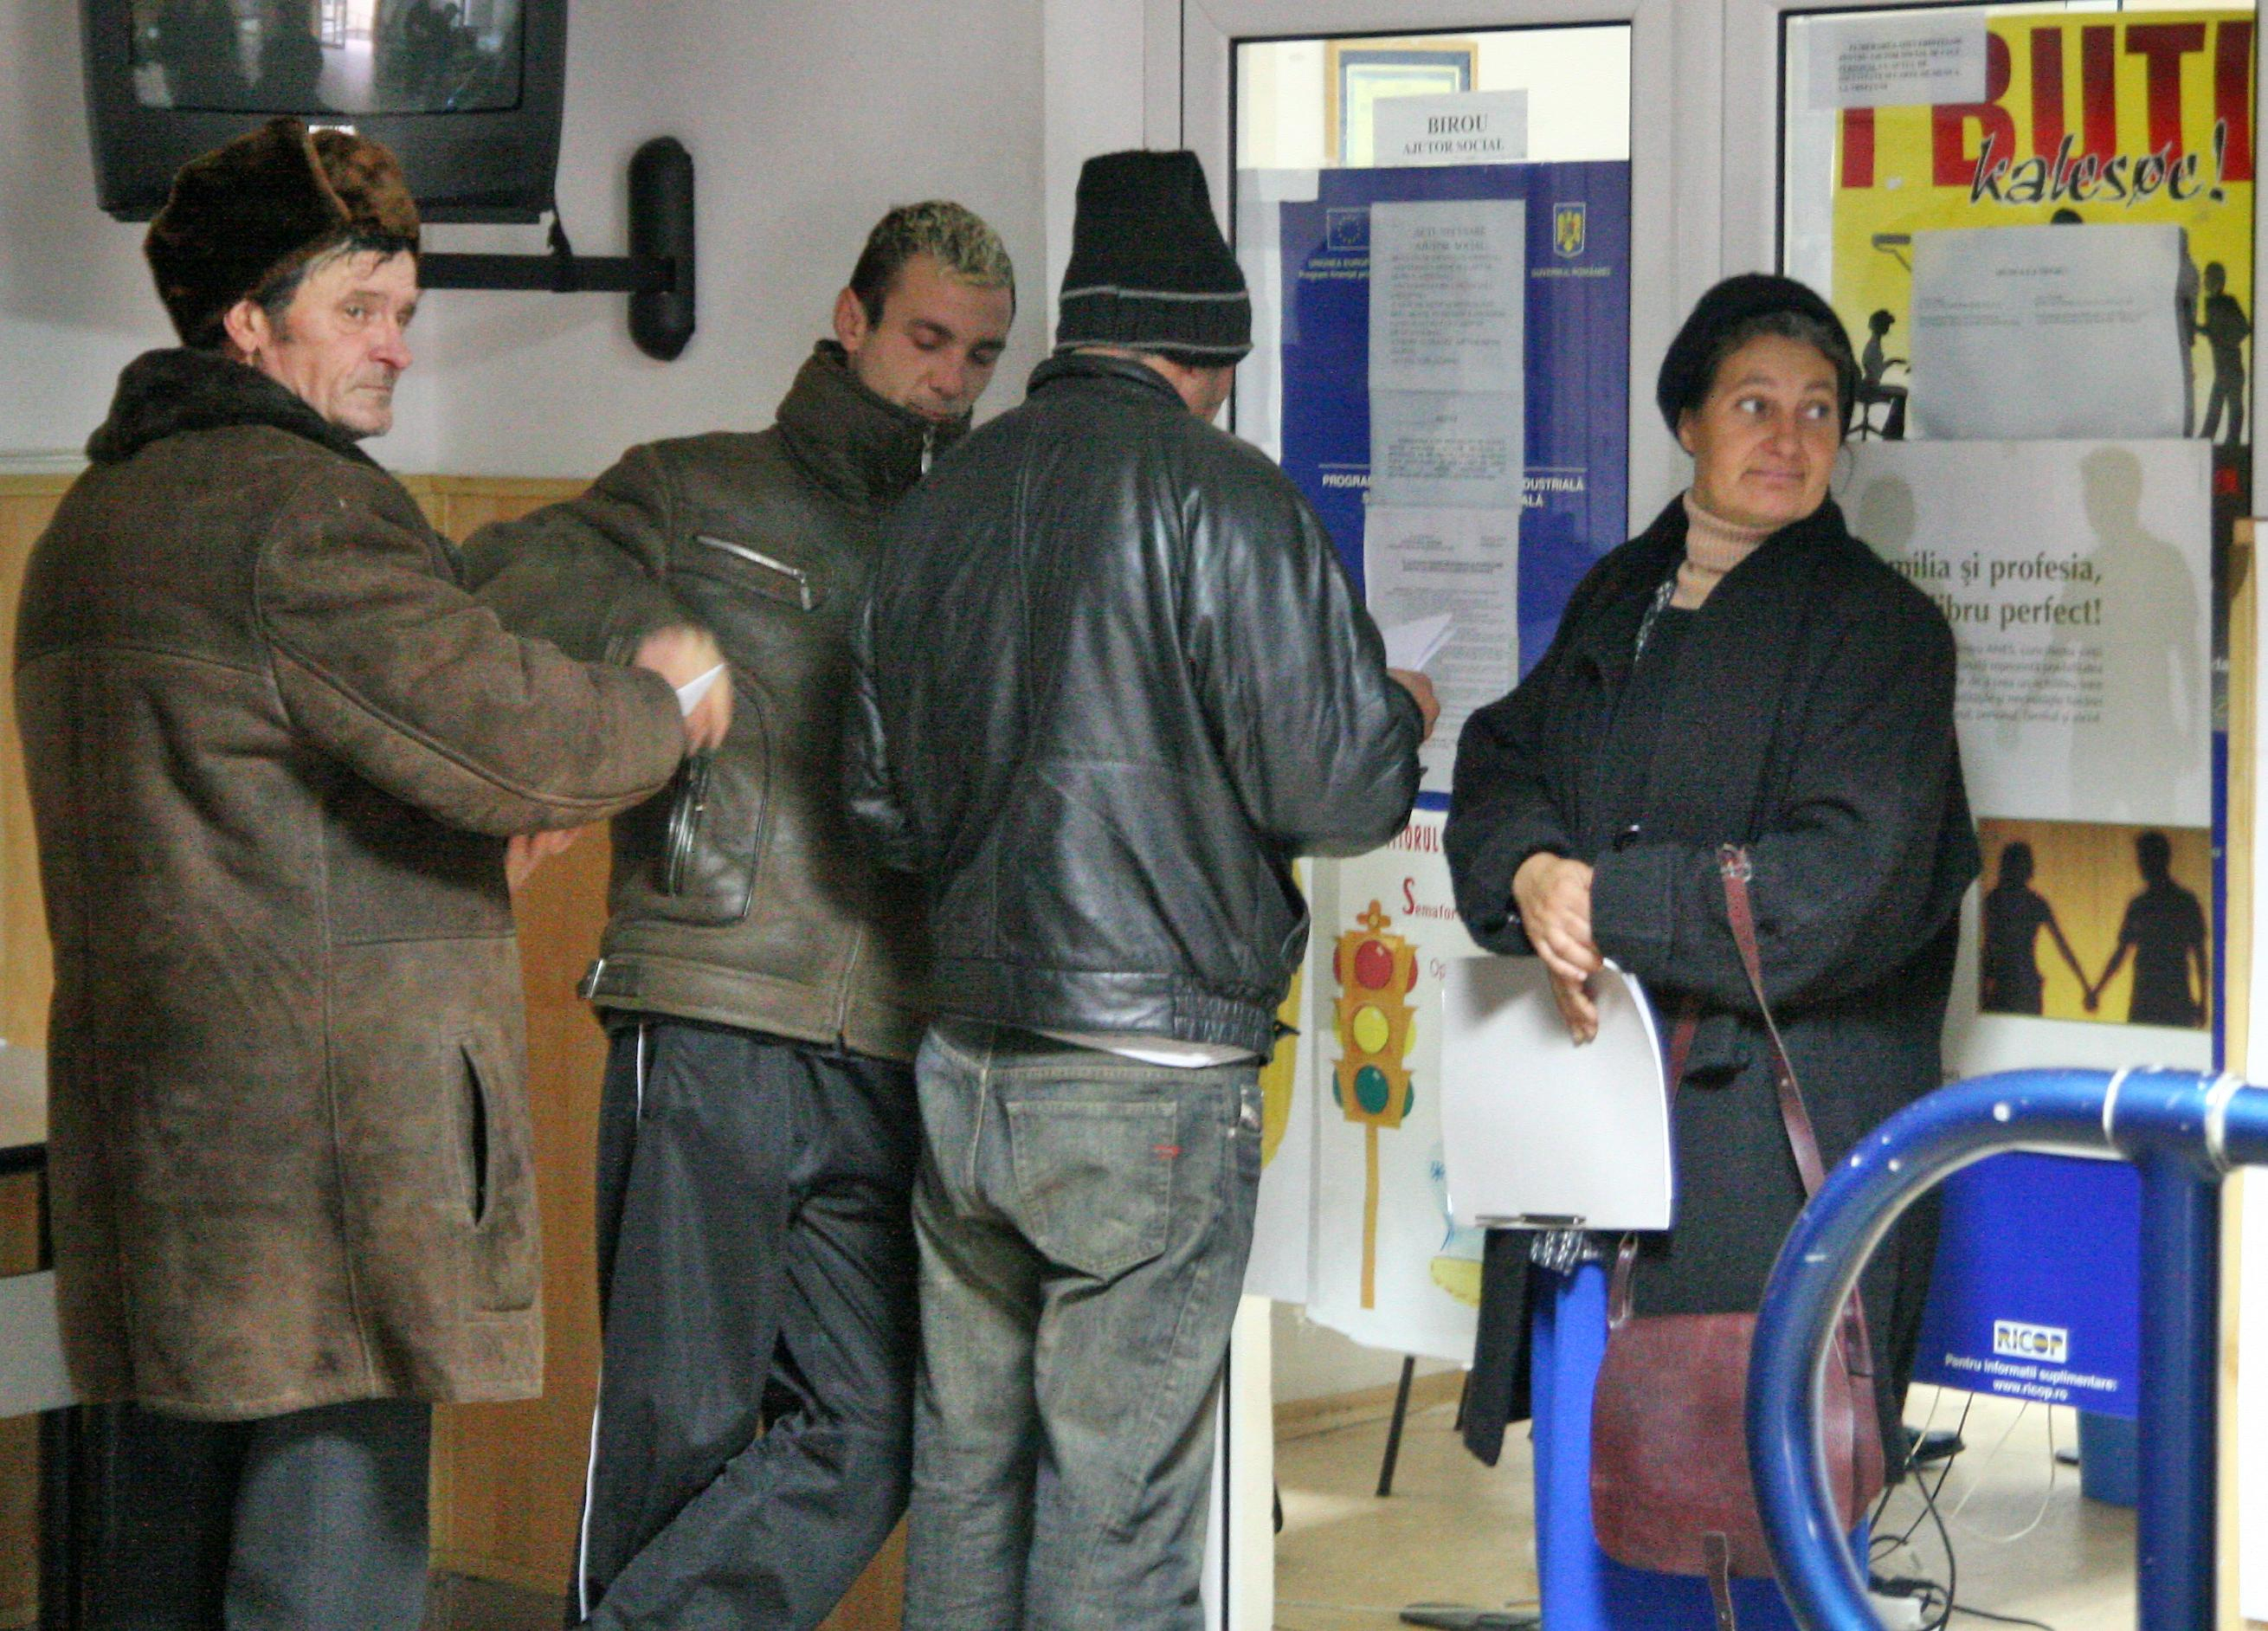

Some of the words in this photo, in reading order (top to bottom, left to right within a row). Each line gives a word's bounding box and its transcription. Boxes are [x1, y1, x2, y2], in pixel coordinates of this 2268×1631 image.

[1428, 113, 1488, 134] BIROU
[1404, 140, 1453, 154] AJUTOR
[1456, 138, 1504, 151] SOCIAL
[1322, 474, 1371, 488] PROGRA
[1523, 475, 1584, 493] DUSTRIALĂ
[1990, 551, 2101, 587] profesia,
[2000, 596, 2101, 631] perfect!
[1997, 1327, 2064, 1357] RICOP
[1945, 1352, 1982, 1371] Pentru
[2039, 1368, 2118, 1392] suplimentare:
[1993, 1378, 2069, 1402] www.ricop.ro
